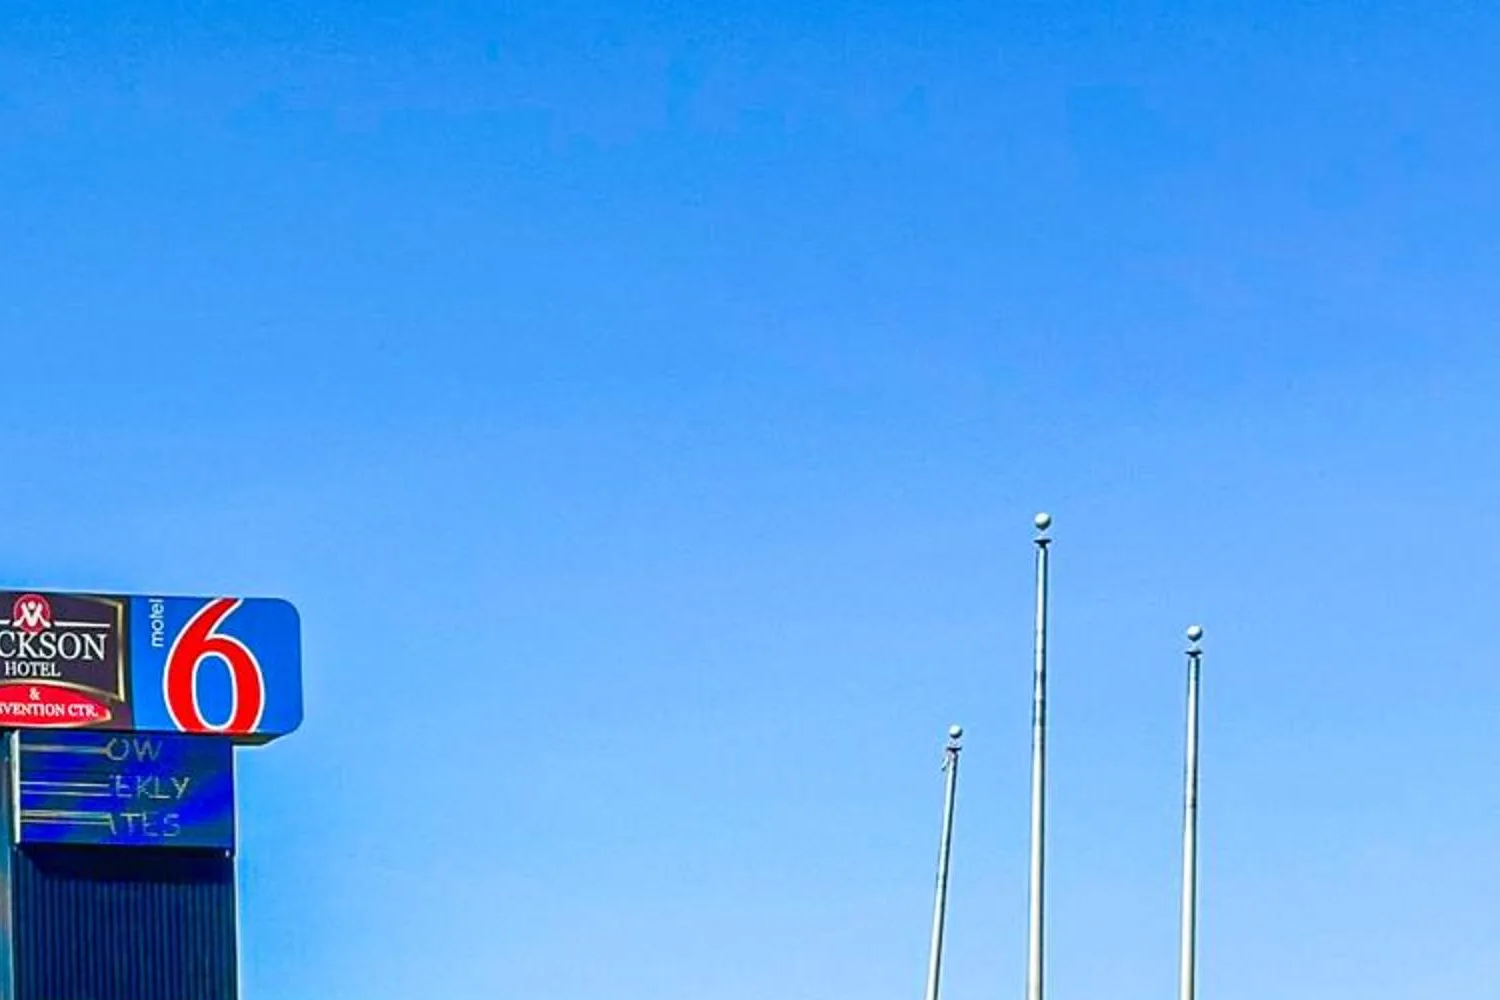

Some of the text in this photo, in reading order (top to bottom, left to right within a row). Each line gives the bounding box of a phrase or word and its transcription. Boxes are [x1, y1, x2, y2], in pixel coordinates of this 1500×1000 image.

[4, 661, 61, 677] HOTEL
[150, 597, 266, 733] motel 6
[30, 688, 41, 701] &
